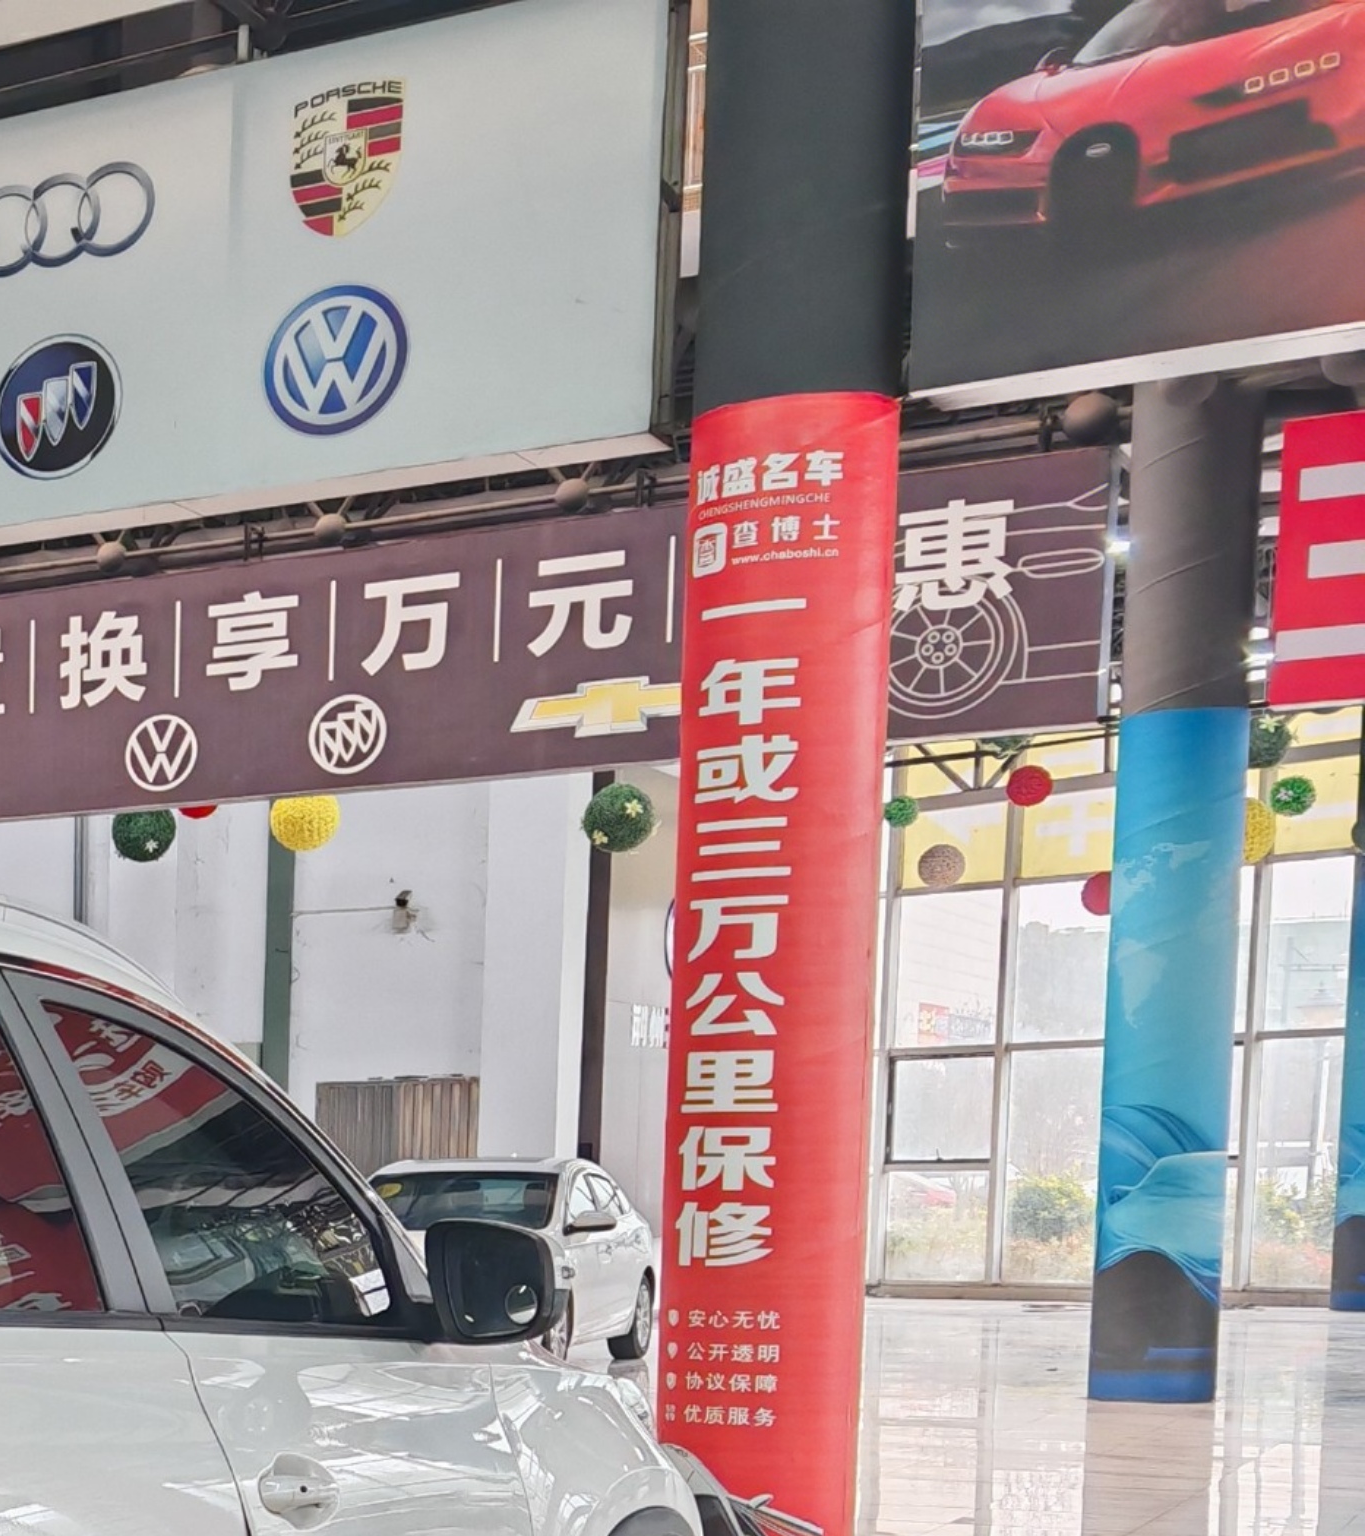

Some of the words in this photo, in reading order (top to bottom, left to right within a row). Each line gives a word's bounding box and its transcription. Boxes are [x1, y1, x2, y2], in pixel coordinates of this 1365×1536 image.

[294, 80, 402, 118] PORSCHE
[697, 450, 844, 506] 诚盛名车
[698, 492, 831, 521] CHENGSHENGMINGCHE
[732, 513, 840, 549] 查博士
[731, 547, 839, 566] www.chaboshi.cn
[894, 499, 1016, 613] 惠
[676, 597, 807, 1268] 一年或三万公里保修
[688, 1309, 781, 1330] 安心无忧
[687, 1342, 780, 1363] 公开透明
[685, 1371, 779, 1393] 协议保障
[683, 1404, 777, 1427] 优质服务
